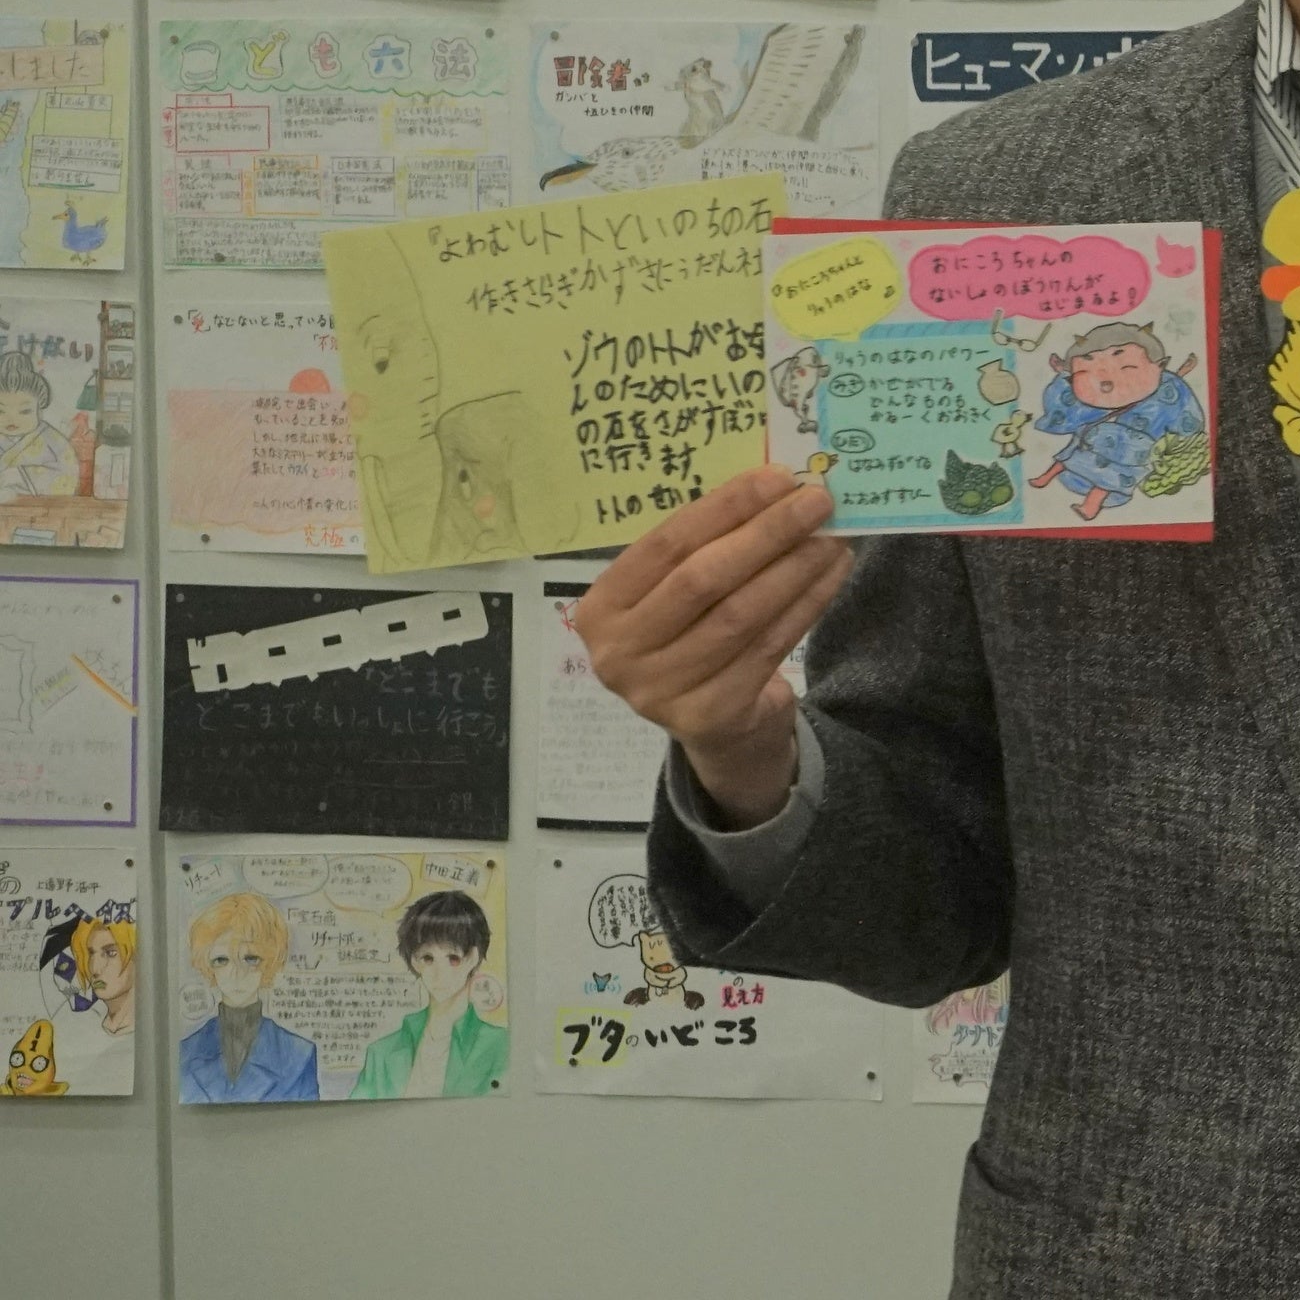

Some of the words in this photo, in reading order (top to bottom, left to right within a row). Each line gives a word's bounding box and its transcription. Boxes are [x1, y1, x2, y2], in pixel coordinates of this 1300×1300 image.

[181, 31, 476, 81] こども六法
[931, 249, 1074, 275] おにころちゃんの
[927, 272, 1106, 304] ないしょのぼうけんが
[832, 345, 991, 367] りゅうのはなのパワー
[721, 984, 766, 1008] 見え方
[562, 1014, 760, 1063] ブタのいどころ
